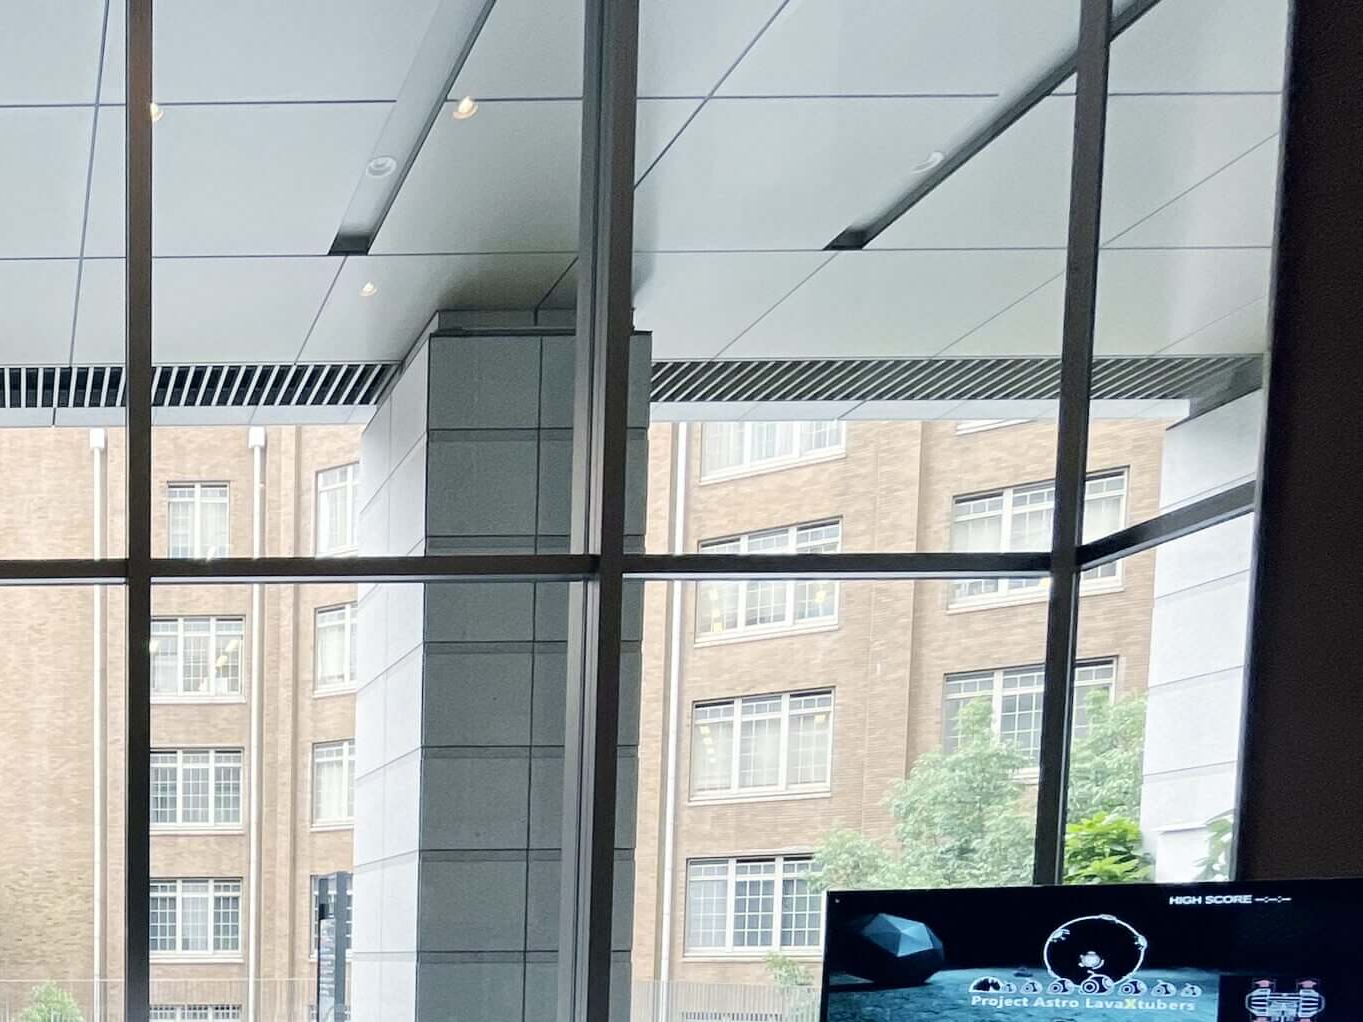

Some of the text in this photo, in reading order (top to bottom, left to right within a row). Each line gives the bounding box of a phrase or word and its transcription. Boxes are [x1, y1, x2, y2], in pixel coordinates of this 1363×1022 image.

[1169, 895, 1202, 906] HIGH
[1205, 894, 1252, 905] SCORE
[970, 995, 1196, 1011] Project Astro LavaXtubers
